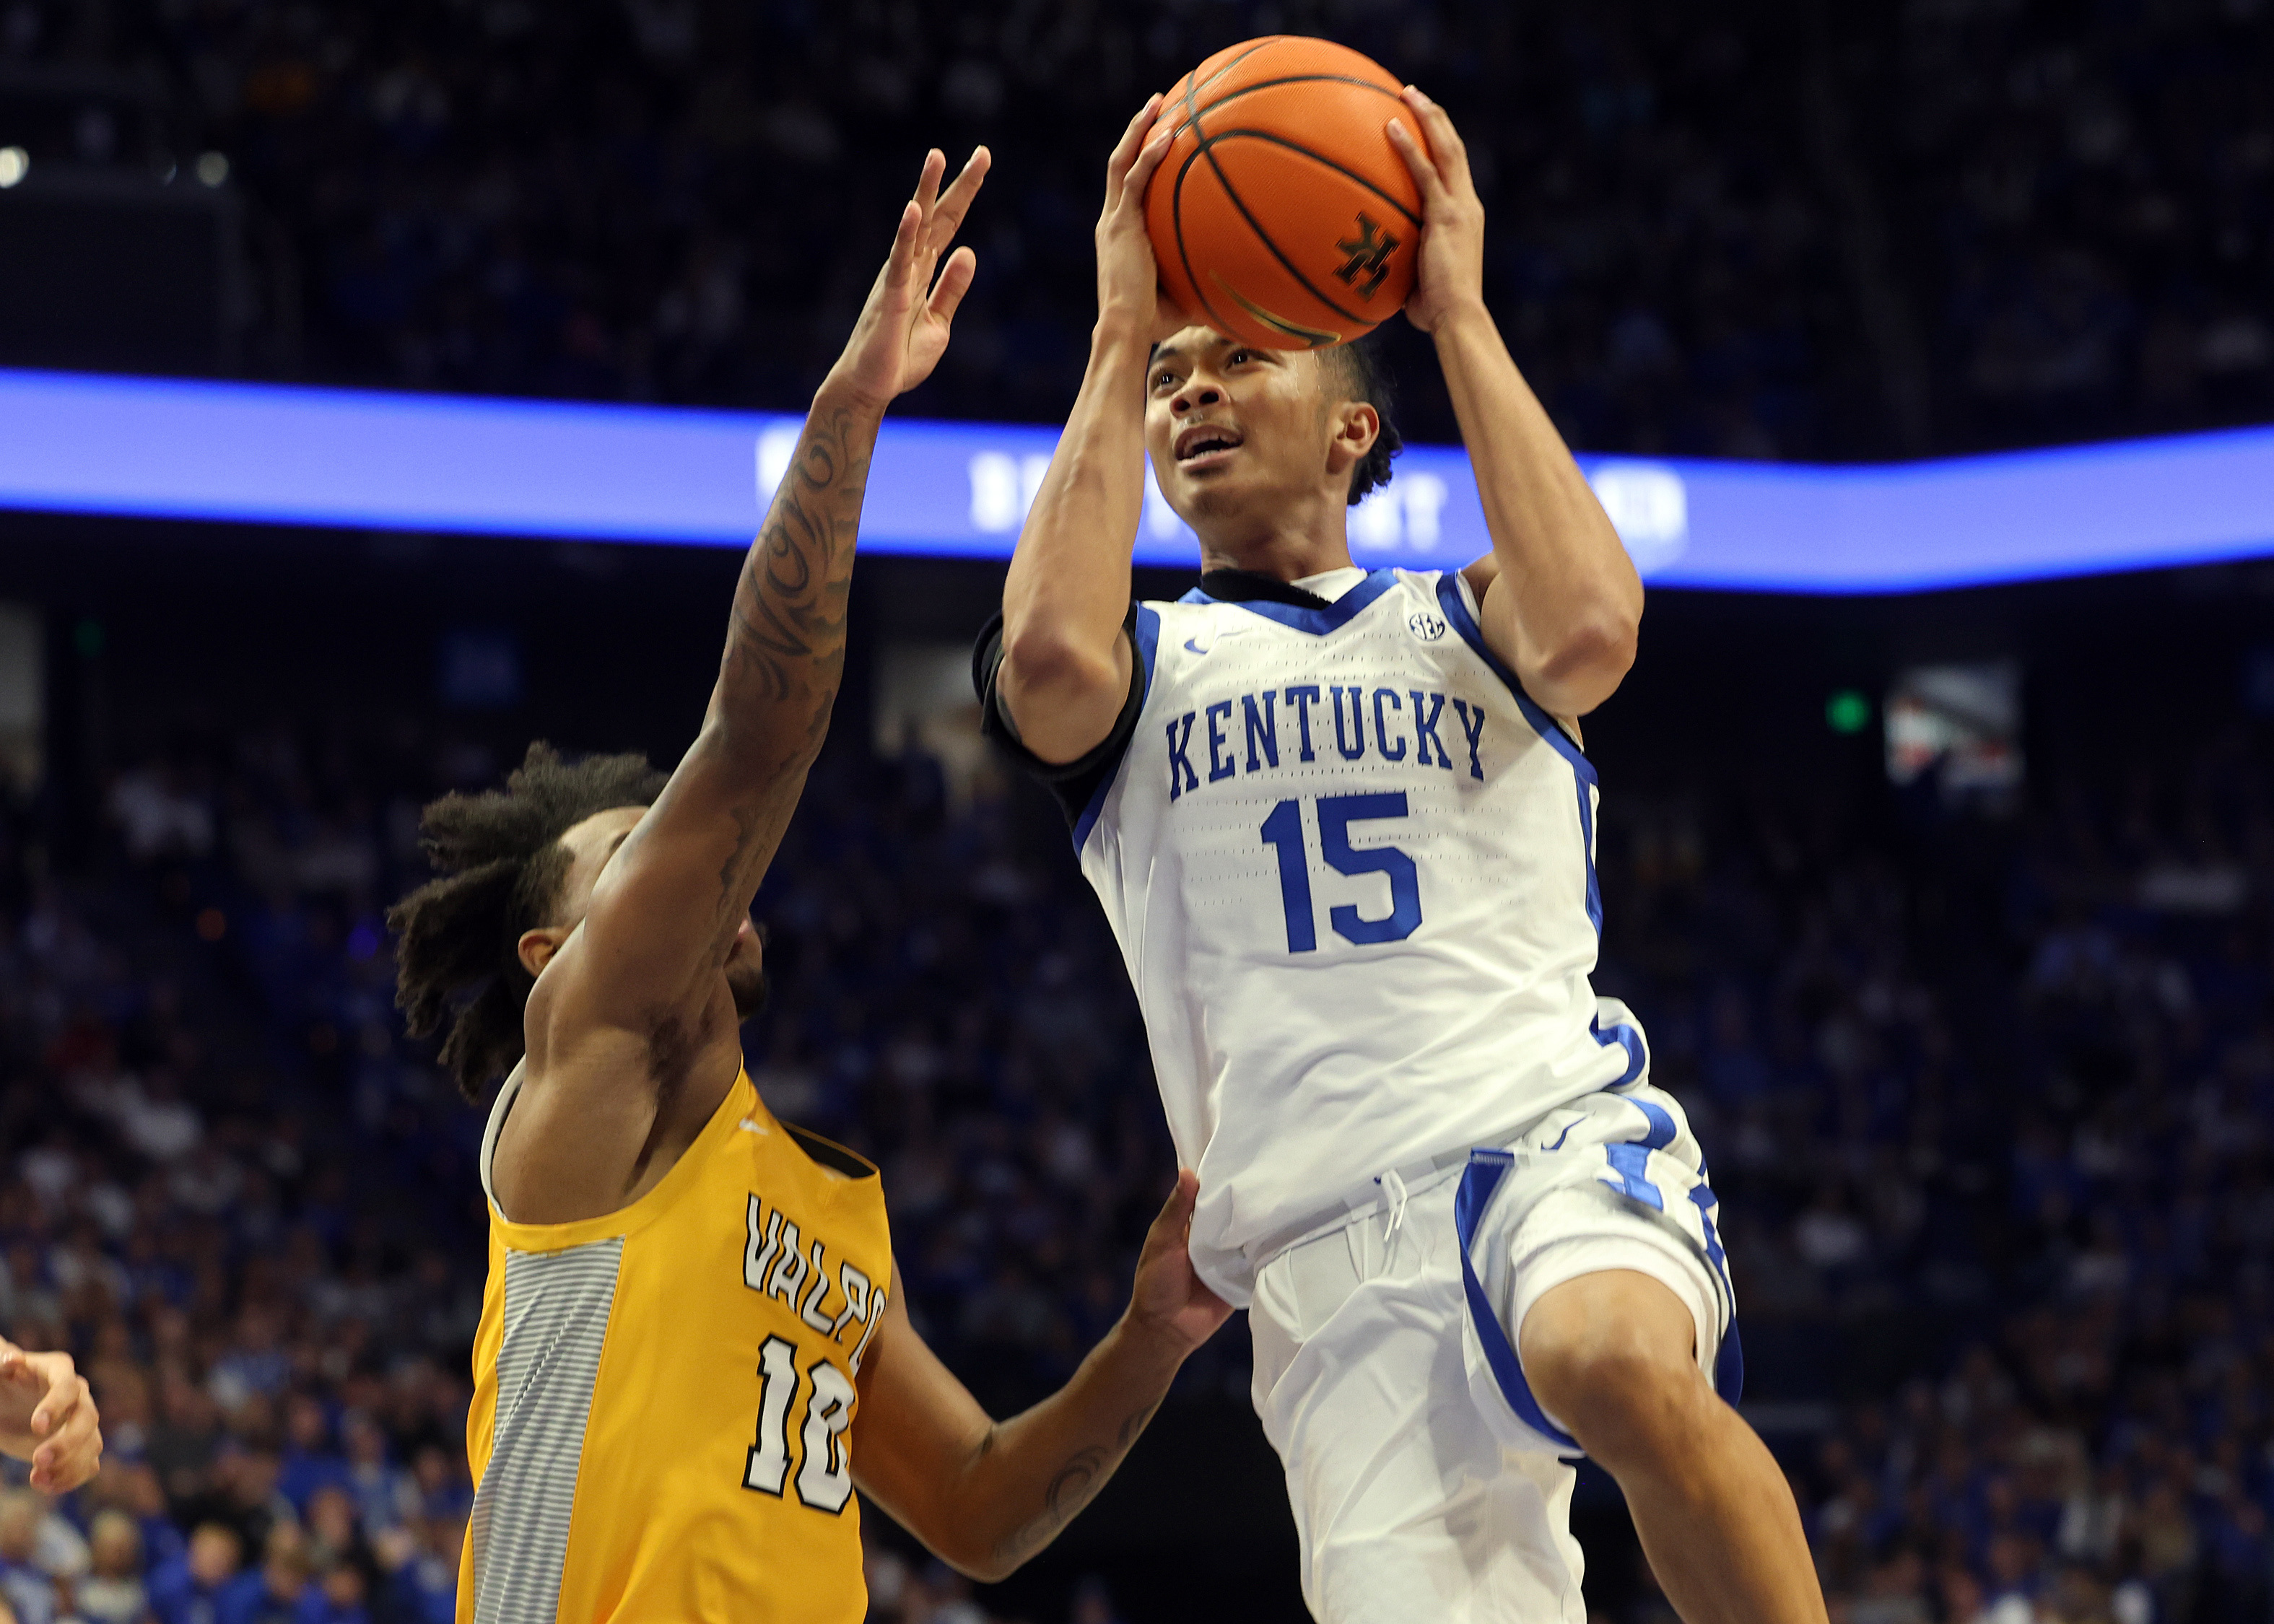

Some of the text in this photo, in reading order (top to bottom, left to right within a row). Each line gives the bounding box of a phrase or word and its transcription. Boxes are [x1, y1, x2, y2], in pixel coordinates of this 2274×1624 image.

[1409, 613, 1445, 641] SEC
[1166, 685, 1486, 803] KENTUCKY
[1260, 791, 1423, 955] 15
[741, 1332, 856, 1516] 10
